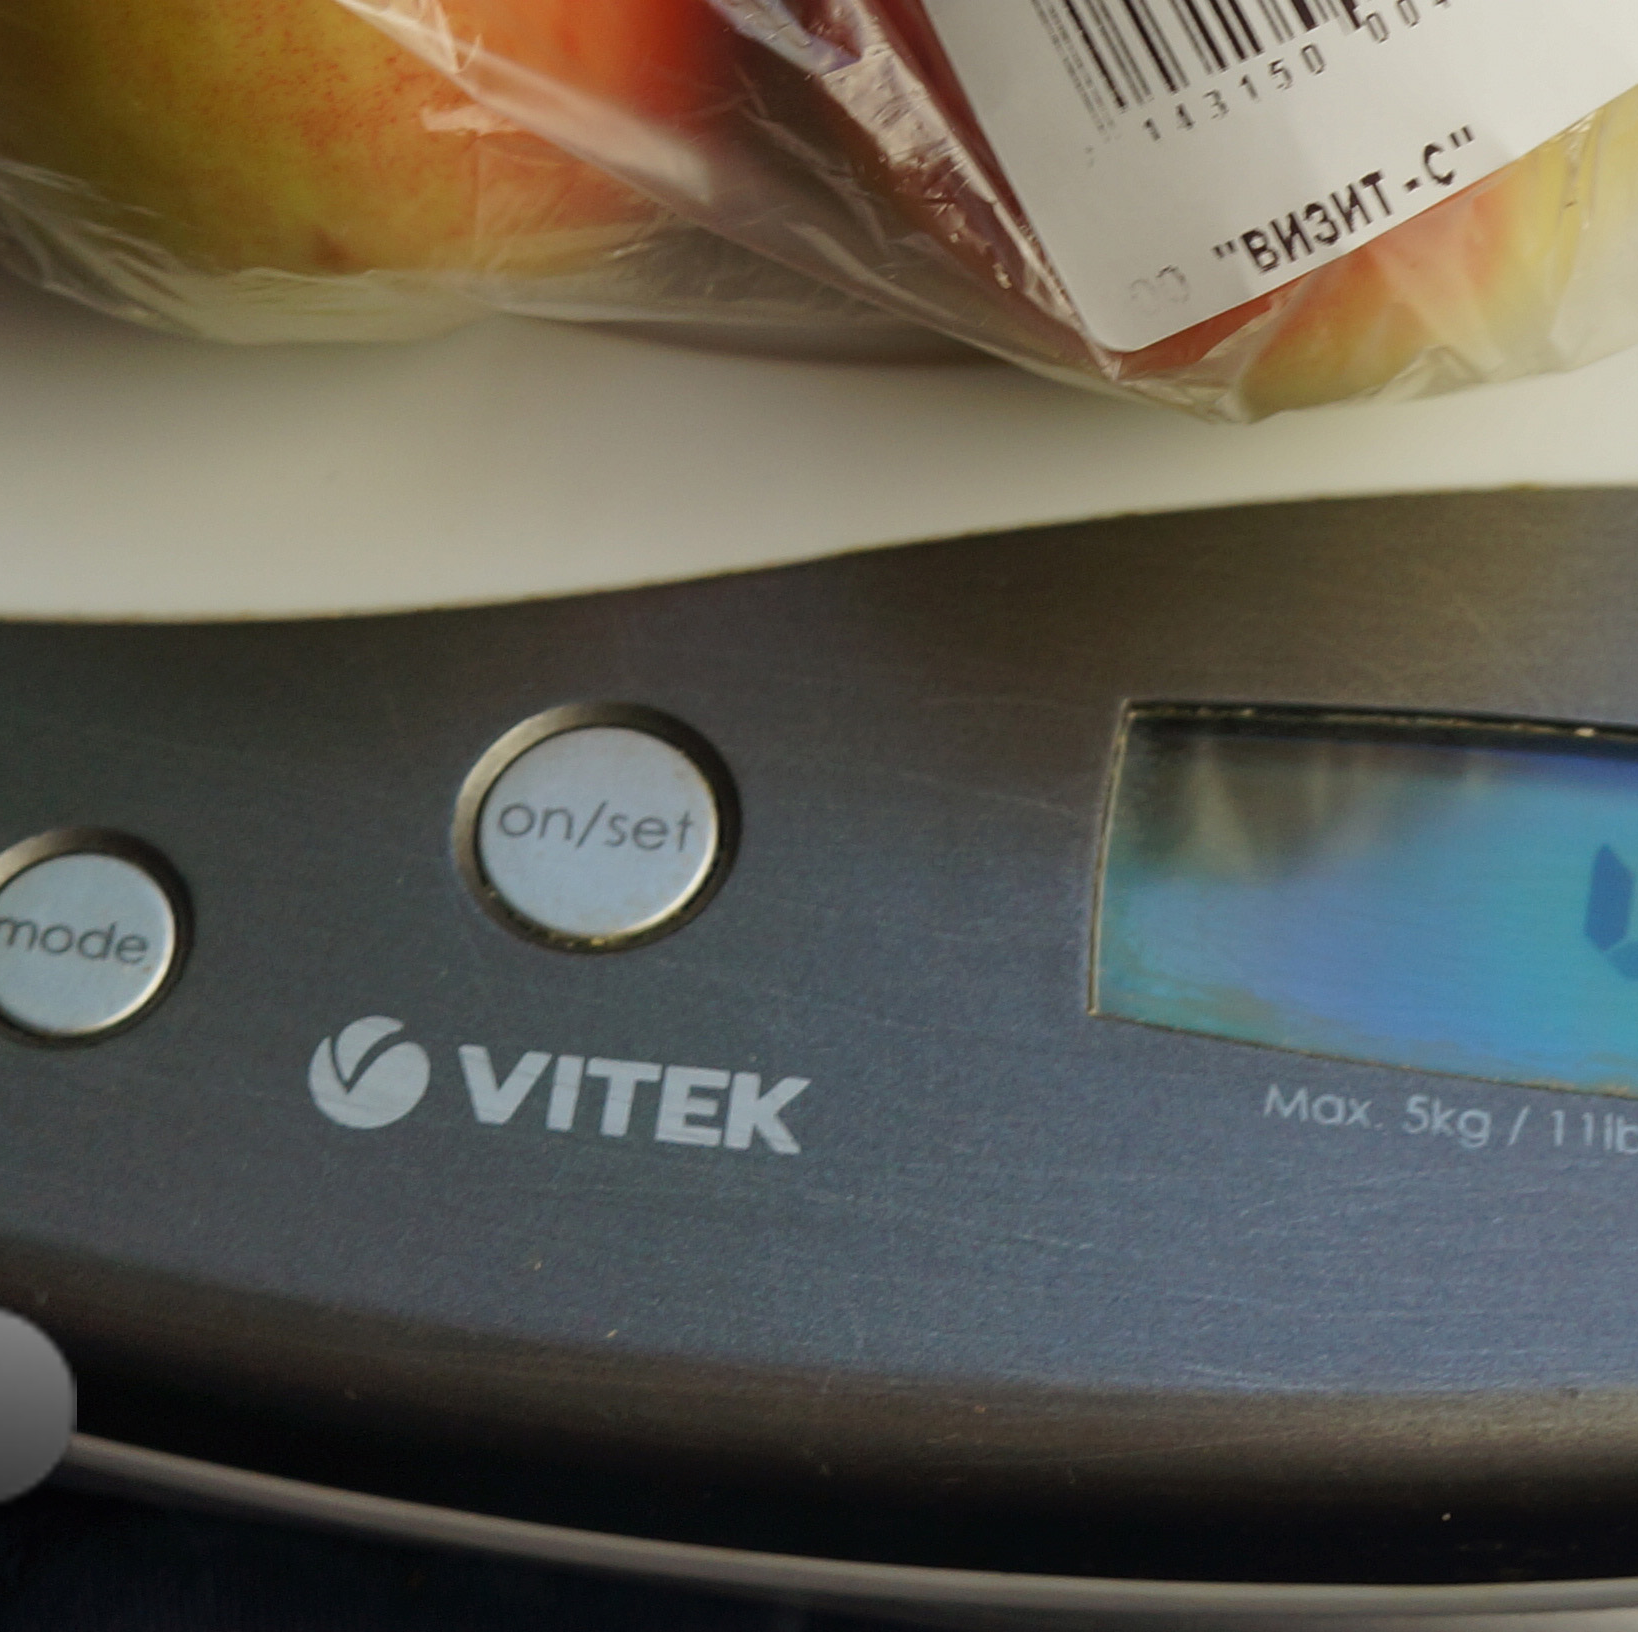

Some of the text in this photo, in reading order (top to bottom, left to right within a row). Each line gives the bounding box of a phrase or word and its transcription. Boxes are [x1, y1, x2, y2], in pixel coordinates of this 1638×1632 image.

[496, 799, 696, 853] on/set
[457, 1042, 812, 1156] VITEK
[1264, 1082, 1386, 1131] Max.
[1400, 1092, 1493, 1150] 5kg
